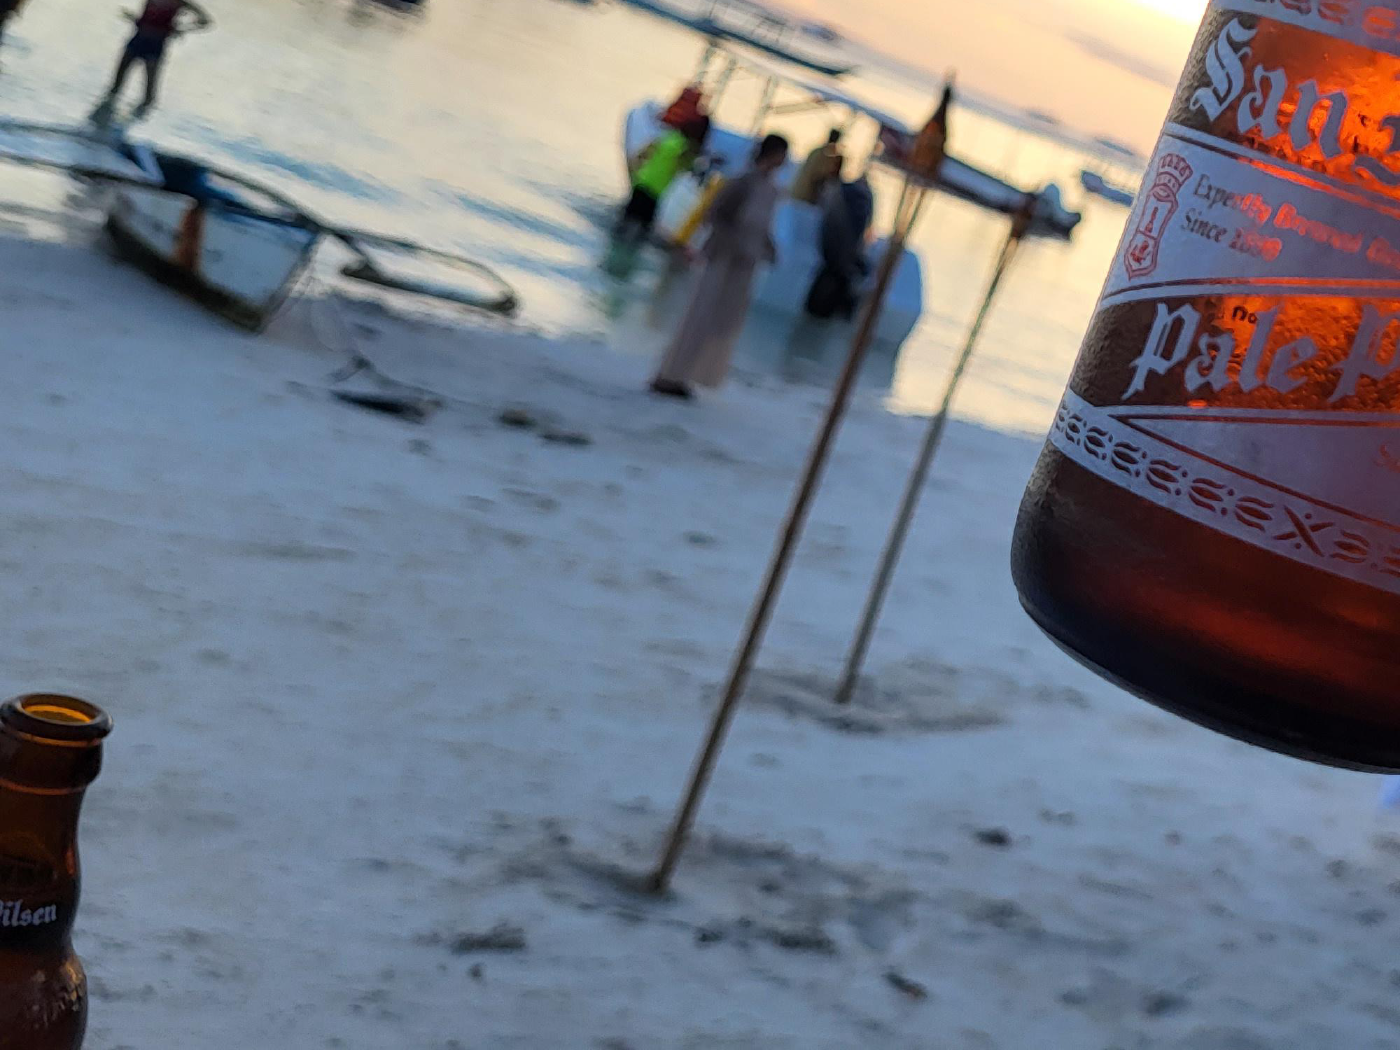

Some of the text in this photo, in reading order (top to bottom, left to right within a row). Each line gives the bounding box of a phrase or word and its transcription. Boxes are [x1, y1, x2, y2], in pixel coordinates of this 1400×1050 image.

[1190, 17, 1348, 159] San
[1180, 206, 1229, 244] Since
[1121, 301, 1318, 401] Pale
